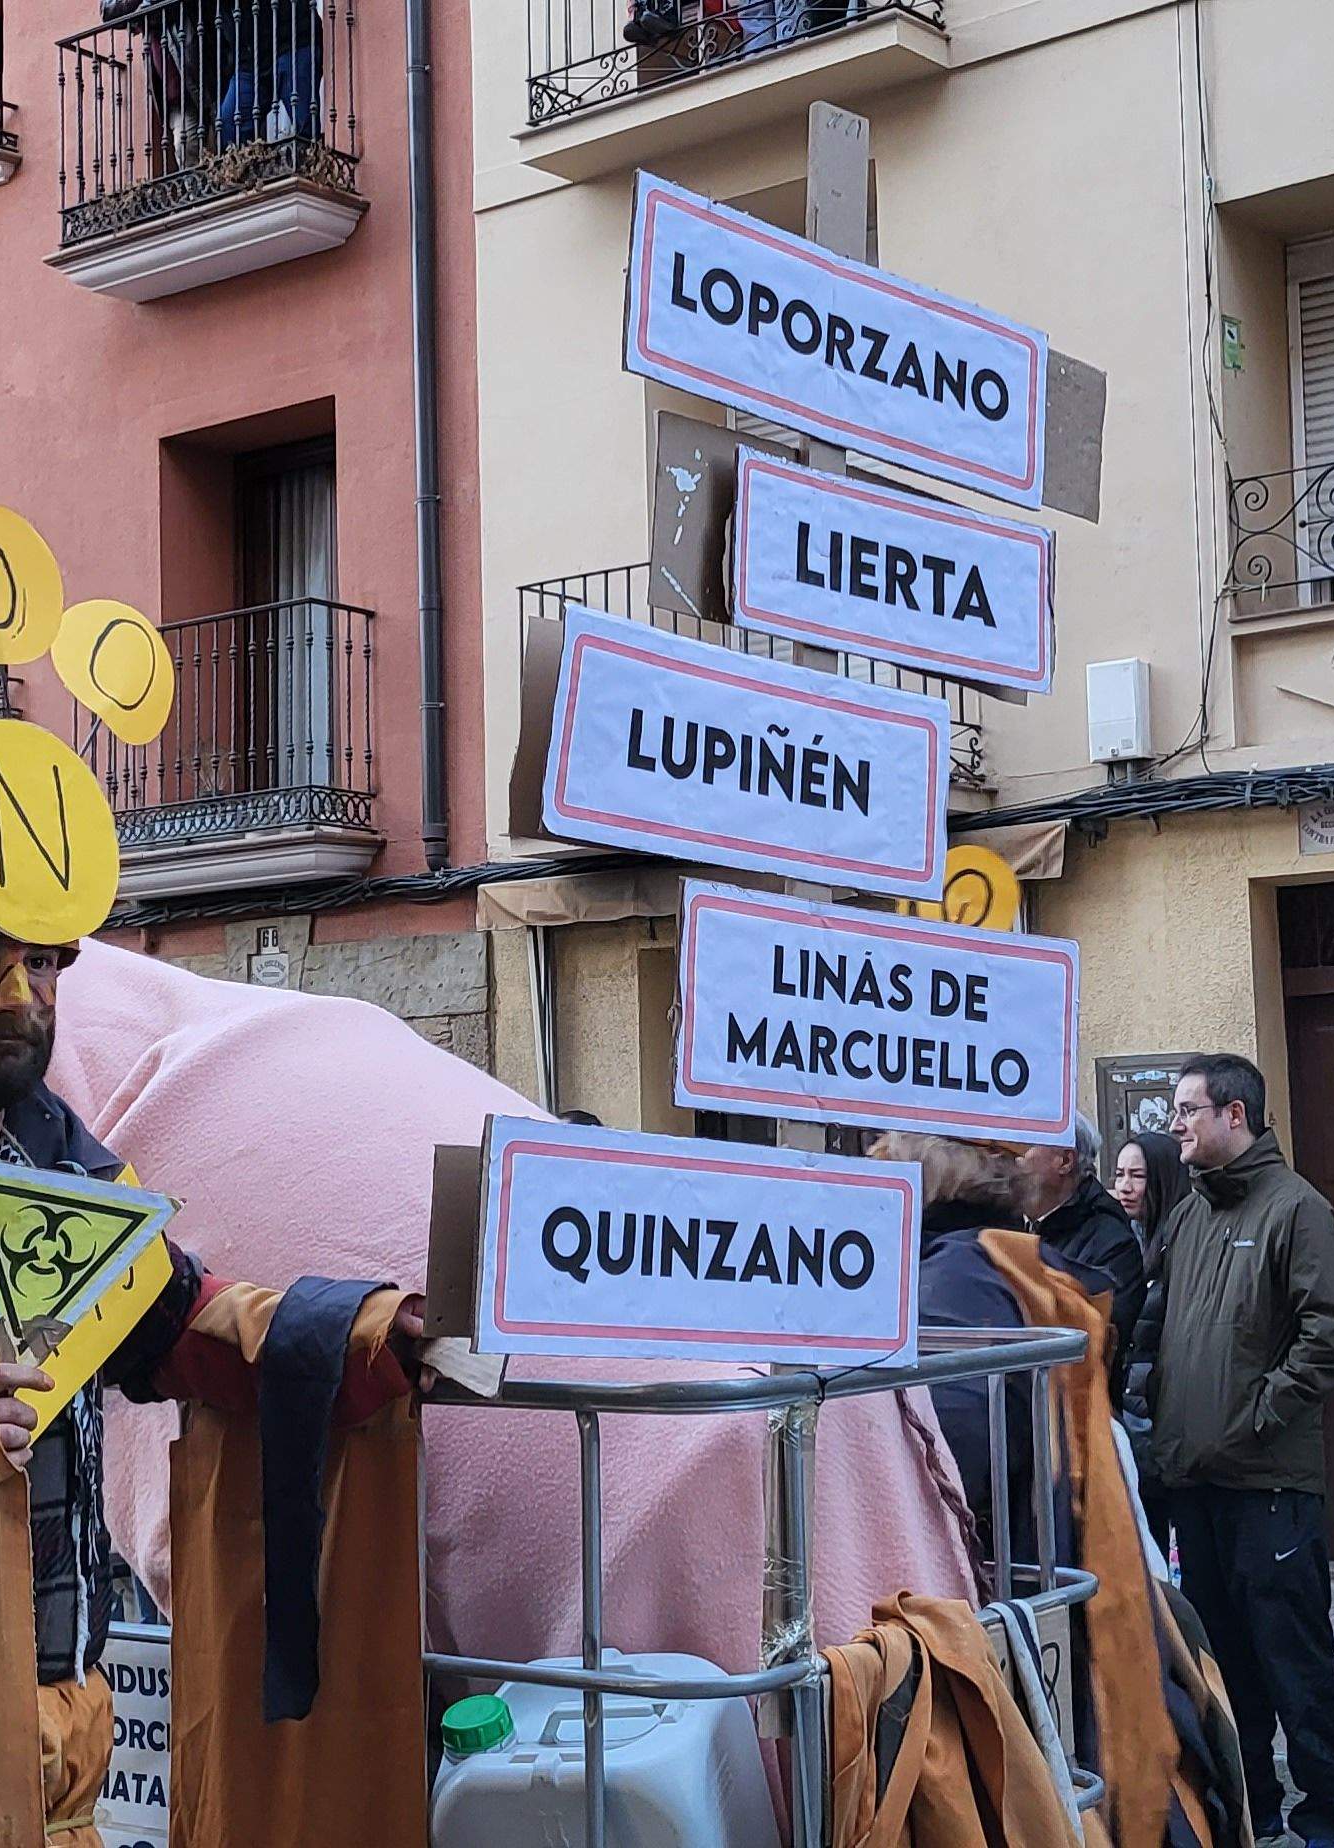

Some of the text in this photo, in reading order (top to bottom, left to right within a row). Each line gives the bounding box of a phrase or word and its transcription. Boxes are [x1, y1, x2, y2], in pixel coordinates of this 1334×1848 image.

[671, 252, 1009, 422] LOPORZANO
[796, 521, 997, 628] LIERTA
[627, 708, 870, 817] LUPIÑÉN
[262, 929, 279, 948] 68
[930, 969, 988, 1022] DE
[727, 1012, 1029, 1097] MARCUELLO
[541, 1206, 875, 1290] QUINZANO
